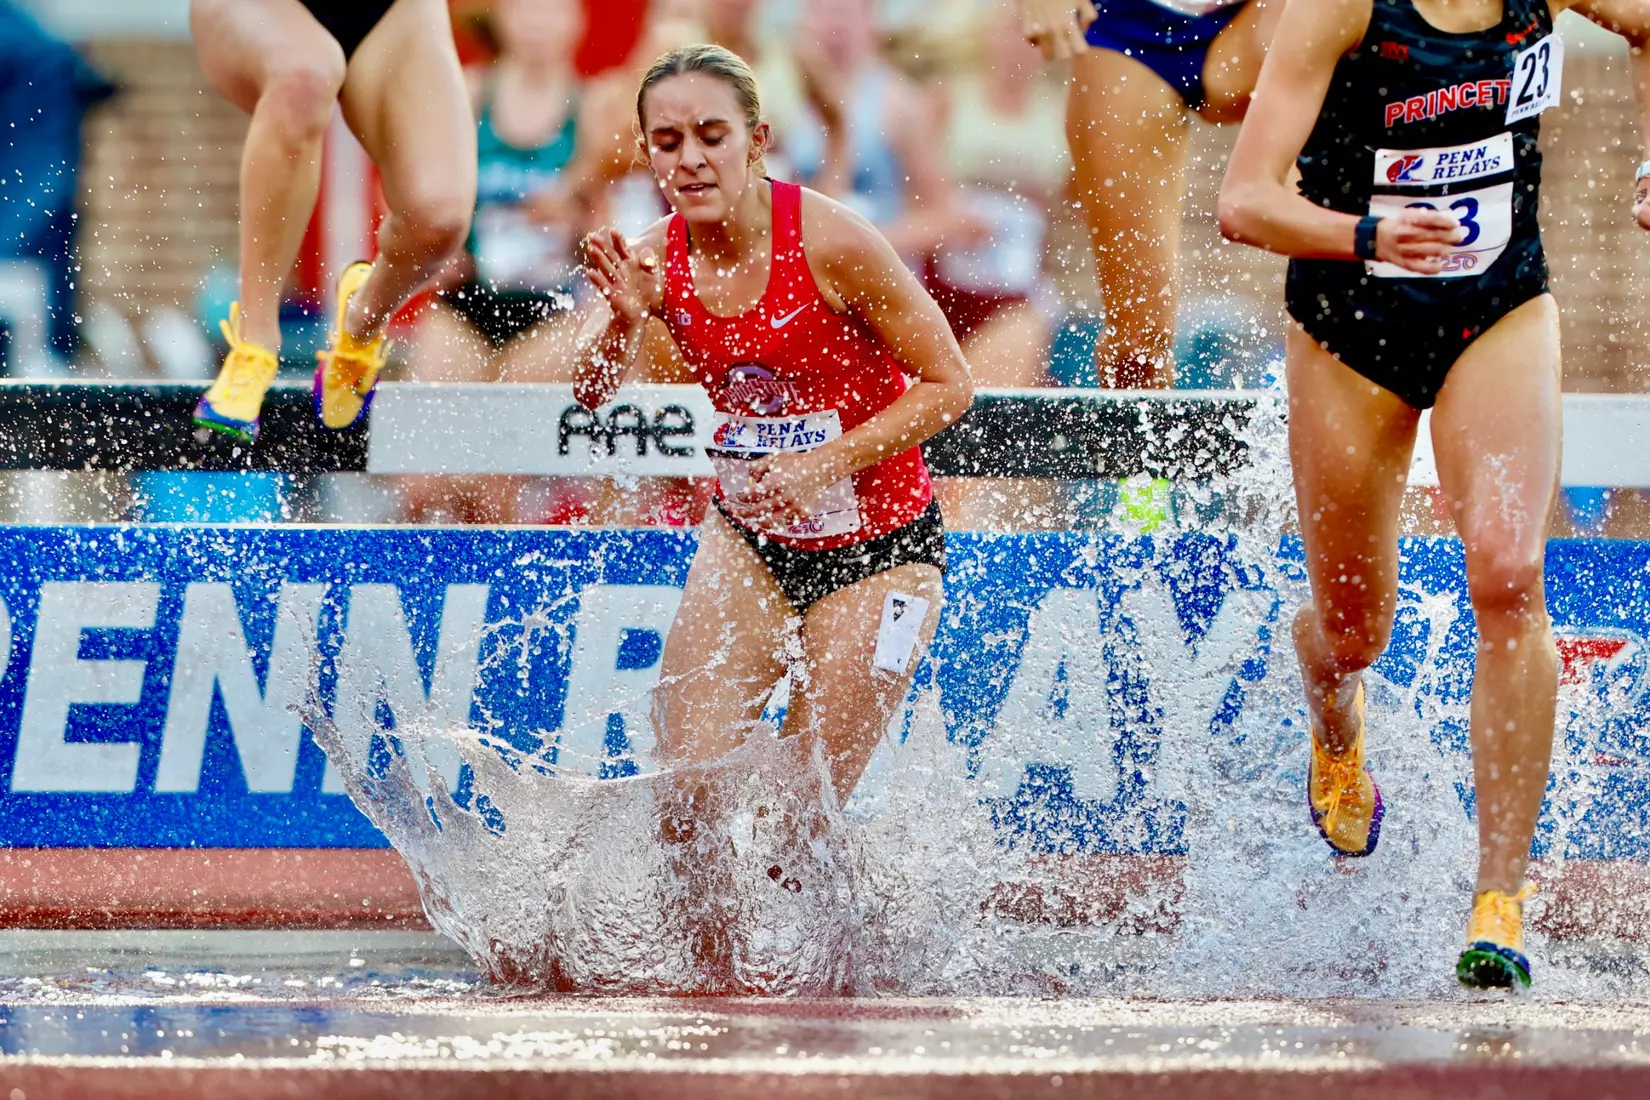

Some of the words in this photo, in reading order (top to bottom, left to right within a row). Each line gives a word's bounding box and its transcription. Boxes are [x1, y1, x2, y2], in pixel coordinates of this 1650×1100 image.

[1516, 42, 1550, 107] 23
[1432, 156, 1501, 180] RELAYS
[1436, 146, 1488, 166] PENN
[1404, 197, 1480, 247] 3
[756, 430, 826, 449] RELAYS
[757, 419, 808, 436] PENN
[0, 581, 491, 794] ENN
